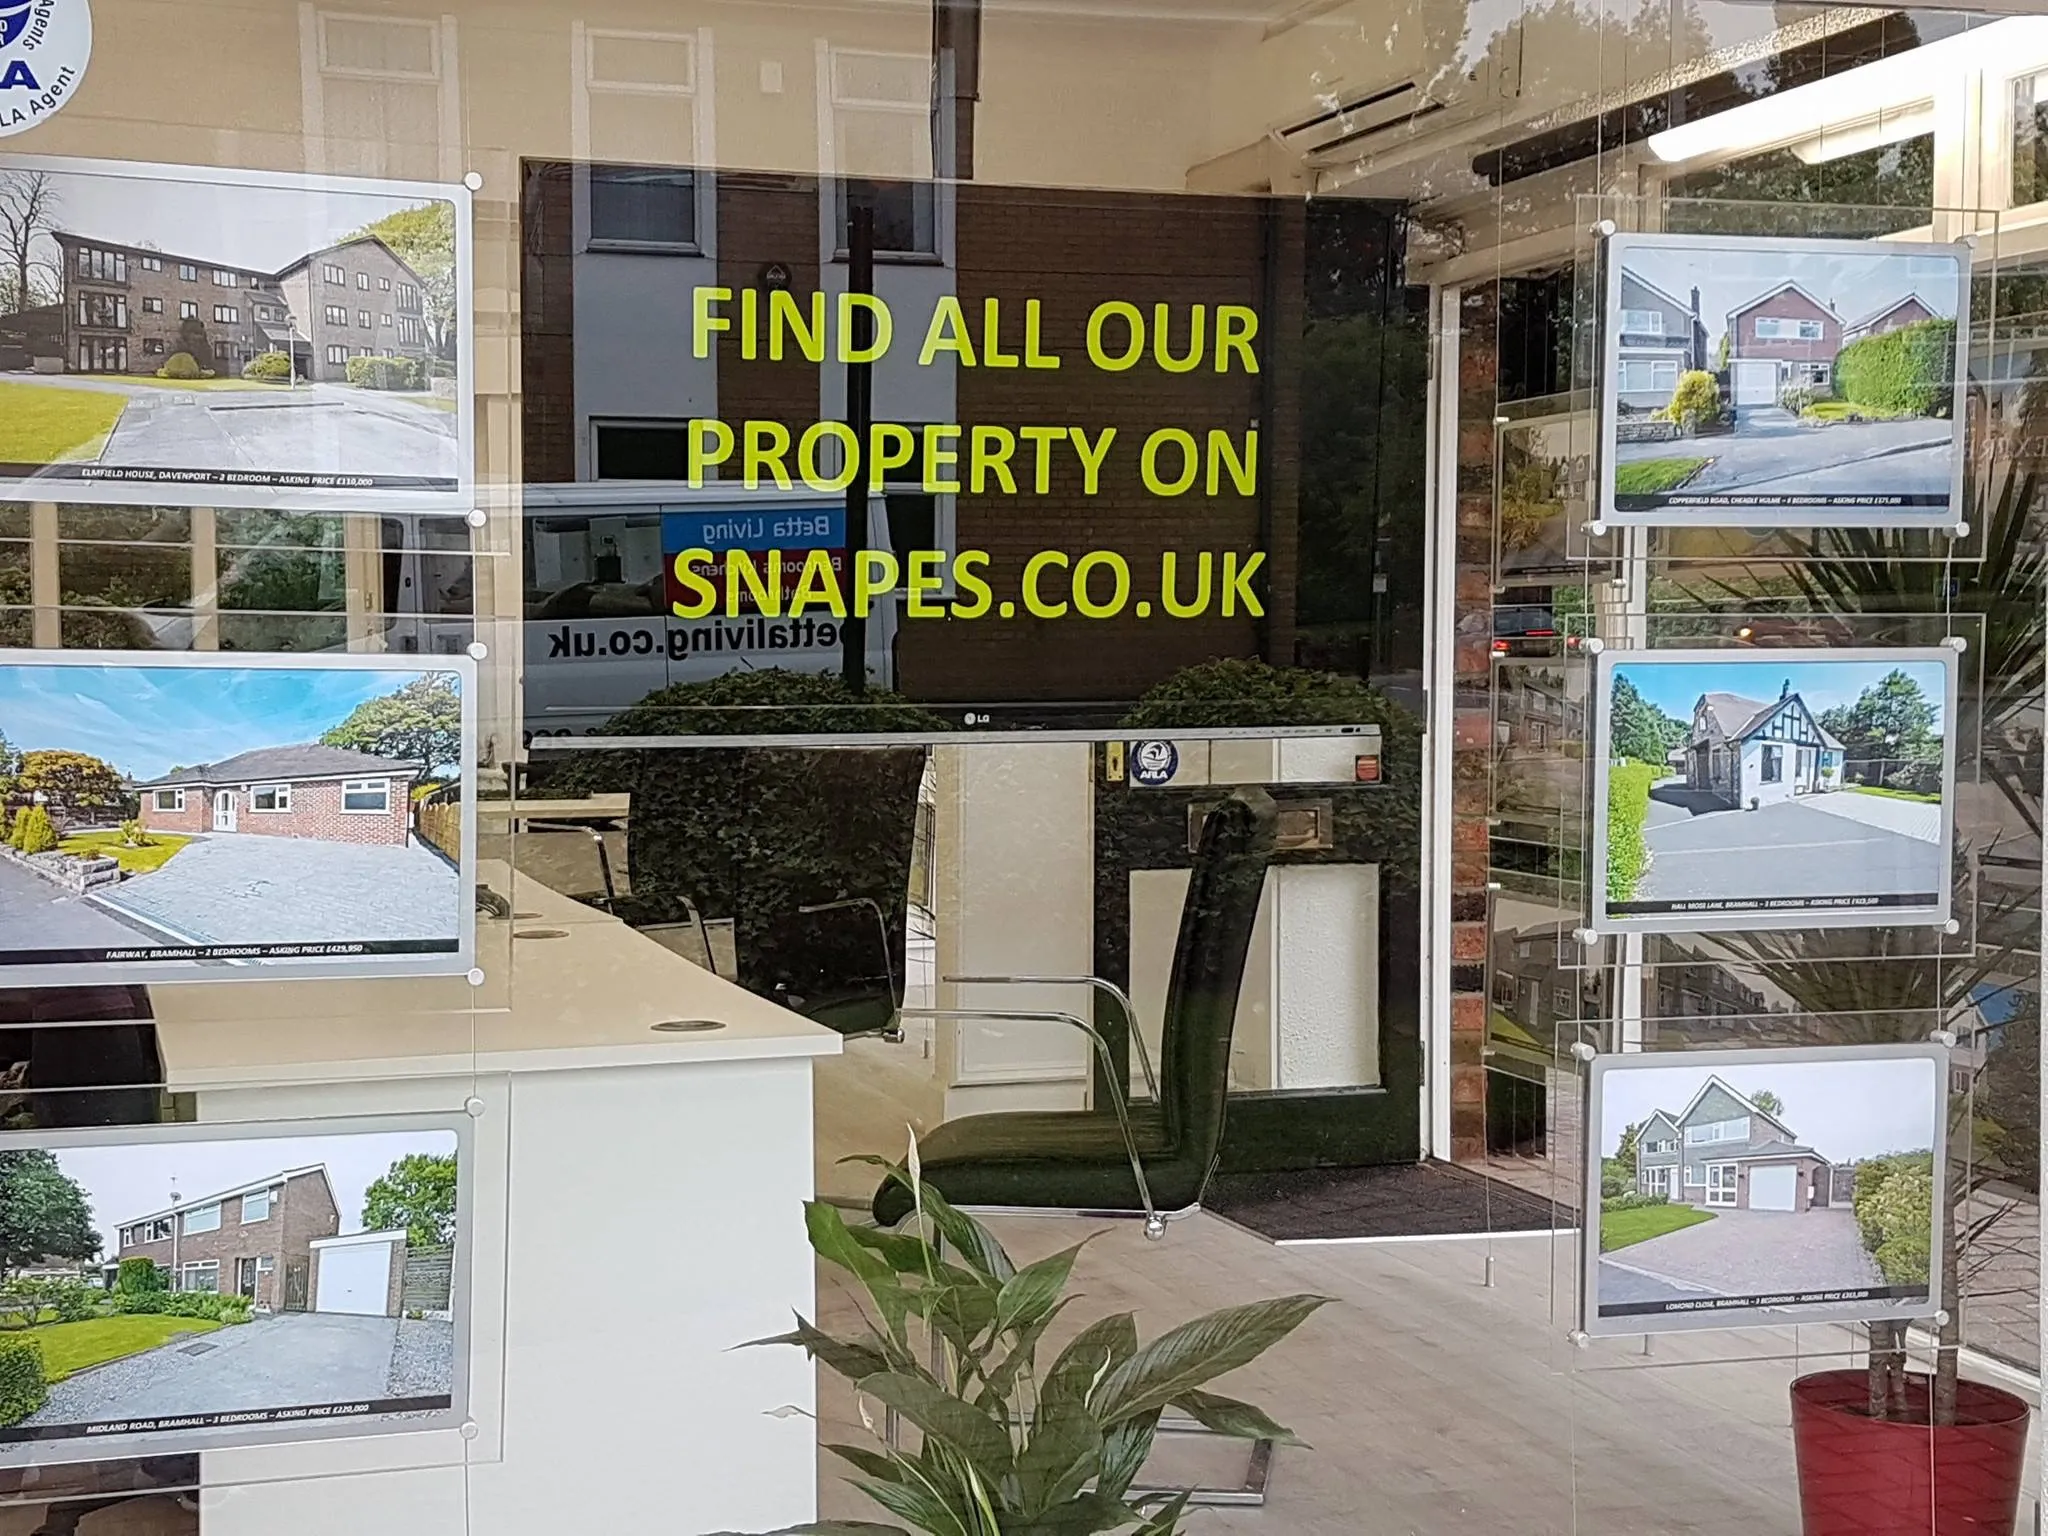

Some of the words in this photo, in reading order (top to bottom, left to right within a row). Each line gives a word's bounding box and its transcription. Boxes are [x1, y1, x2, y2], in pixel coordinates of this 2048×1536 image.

[29, 65, 76, 115] Agent
[692, 286, 893, 364] FIND
[919, 295, 1060, 369] ALL
[1085, 300, 1260, 374] OUR
[82, 468, 123, 478] ELMFIELD
[124, 469, 156, 480] HOUSE,
[159, 471, 211, 481] DAVENPORT
[227, 474, 270, 482] BEDROOM
[279, 475, 310, 484] ASKING
[311, 476, 335, 485] PRICE
[687, 418, 1117, 495] PROPERTY
[1139, 427, 1258, 497] ON
[672, 547, 1266, 620] SNAPES.CO.UK
[977, 714, 990, 723] LG
[106, 949, 148, 960] FAIRWAY,
[150, 948, 197, 958] BRAMHALL
[212, 947, 261, 956] BEDROOMS
[269, 946, 301, 955] ASKING
[301, 945, 325, 954] PRICE
[86, 1422, 128, 1434] MIDLAND
[129, 1421, 157, 1431] ROAD,
[158, 1417, 205, 1428] BRAMHALL
[220, 1412, 268, 1423] BEDROOMS
[275, 1409, 307, 1418] ASKING
[308, 1406, 332, 1417] PRICE
